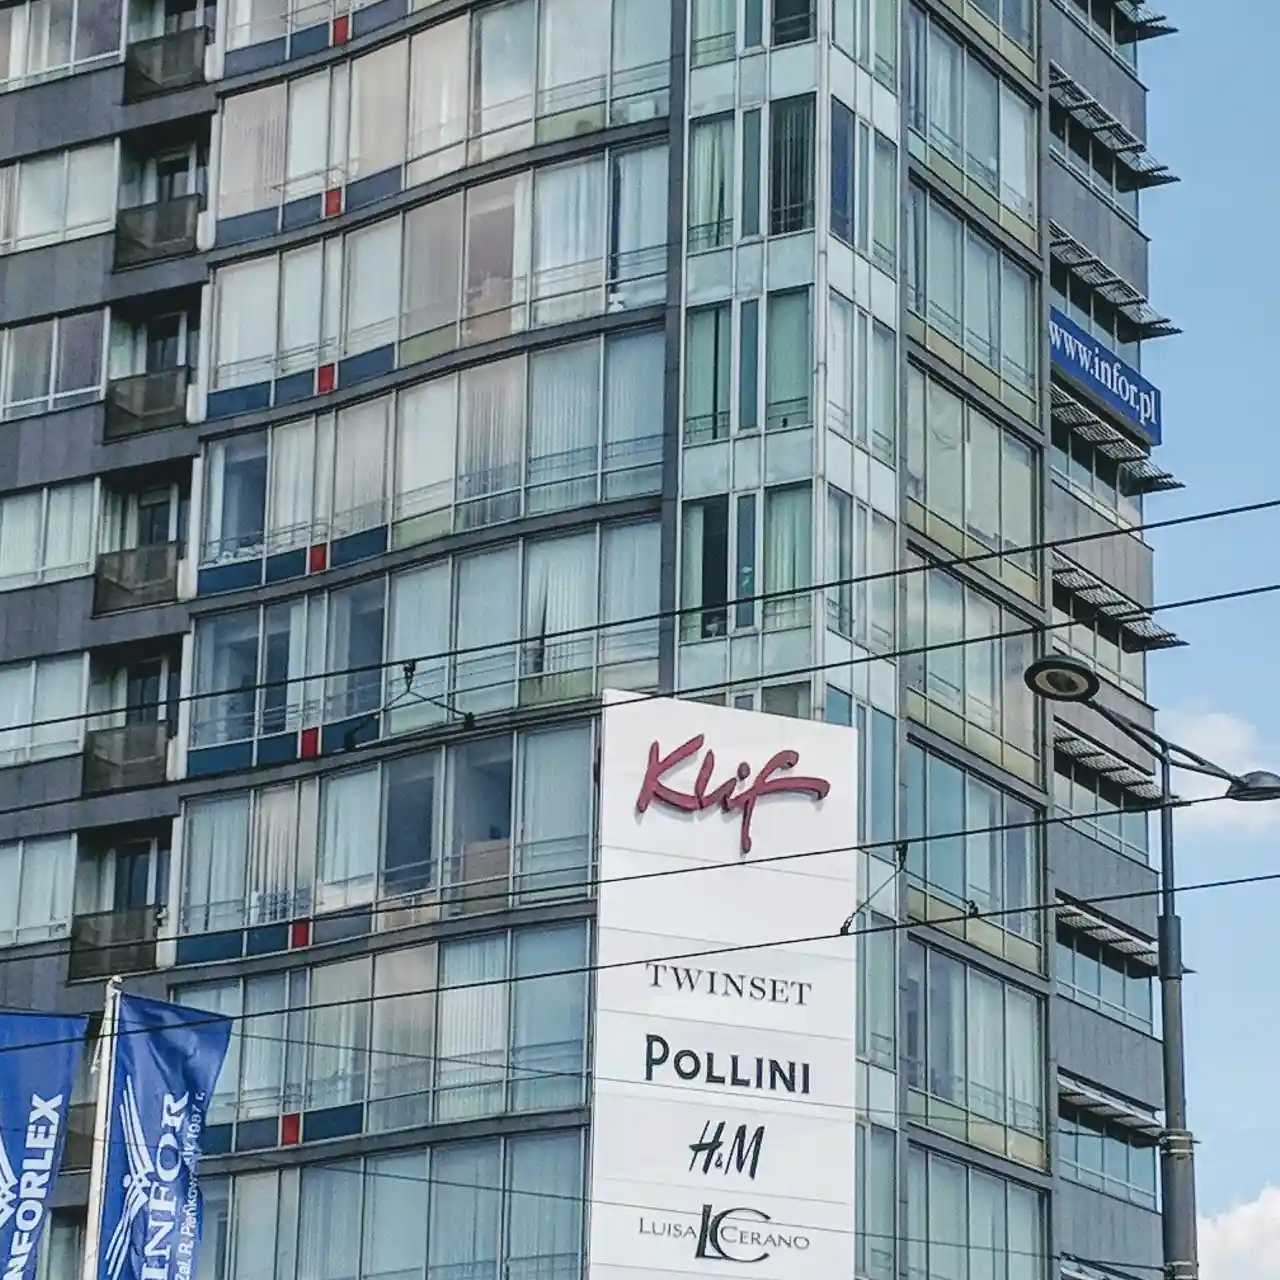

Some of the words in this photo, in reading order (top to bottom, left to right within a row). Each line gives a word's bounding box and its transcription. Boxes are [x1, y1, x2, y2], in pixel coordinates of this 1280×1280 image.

[1049, 320, 1157, 425] www.infor.pl
[635, 733, 831, 854] Klif
[645, 962, 812, 1006] TWINSET
[645, 1033, 811, 1094] POLLINI
[688, 1120, 766, 1180] H&M
[638, 1217, 697, 1240] LUISA
[720, 1225, 810, 1250] CERANO
